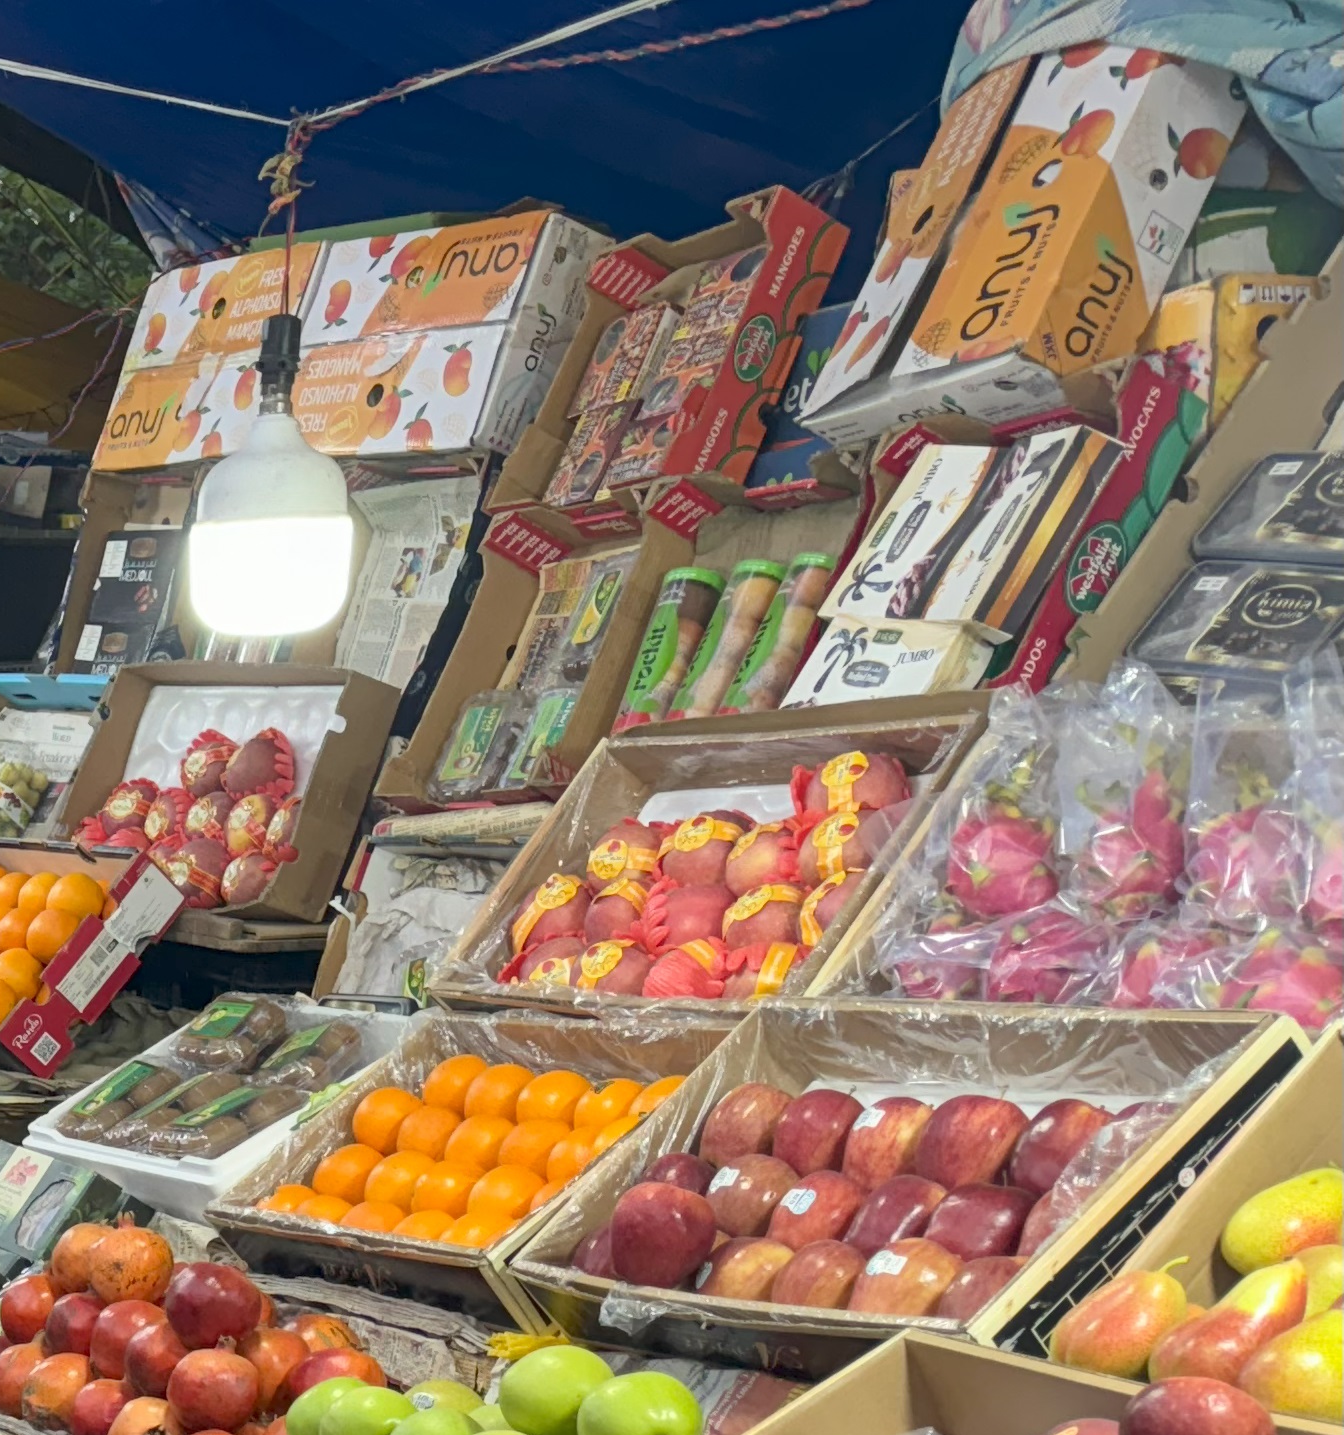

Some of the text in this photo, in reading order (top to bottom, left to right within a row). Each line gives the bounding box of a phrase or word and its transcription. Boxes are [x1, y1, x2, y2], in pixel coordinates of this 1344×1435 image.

[436, 242, 520, 283] anuj
[769, 225, 806, 298] MANGOES
[961, 203, 1060, 341] anuj
[1000, 279, 1029, 327] FRUITS
[1032, 220, 1057, 265] NUTS
[1065, 252, 1133, 358] anuj
[1090, 321, 1114, 367] FRUITS
[1113, 282, 1133, 313] NUTS
[304, 346, 363, 381] MANGOES
[524, 312, 558, 373] anuj
[110, 405, 169, 444] anuj
[297, 383, 362, 408] ALPHONSO
[1123, 385, 1162, 461] AVOCATS
[692, 407, 728, 476] MANGOES
[914, 457, 944, 501] JUMBO
[1075, 536, 1124, 603] westfalia fruit
[632, 617, 668, 693] rockit
[893, 647, 936, 670] JUMBO
